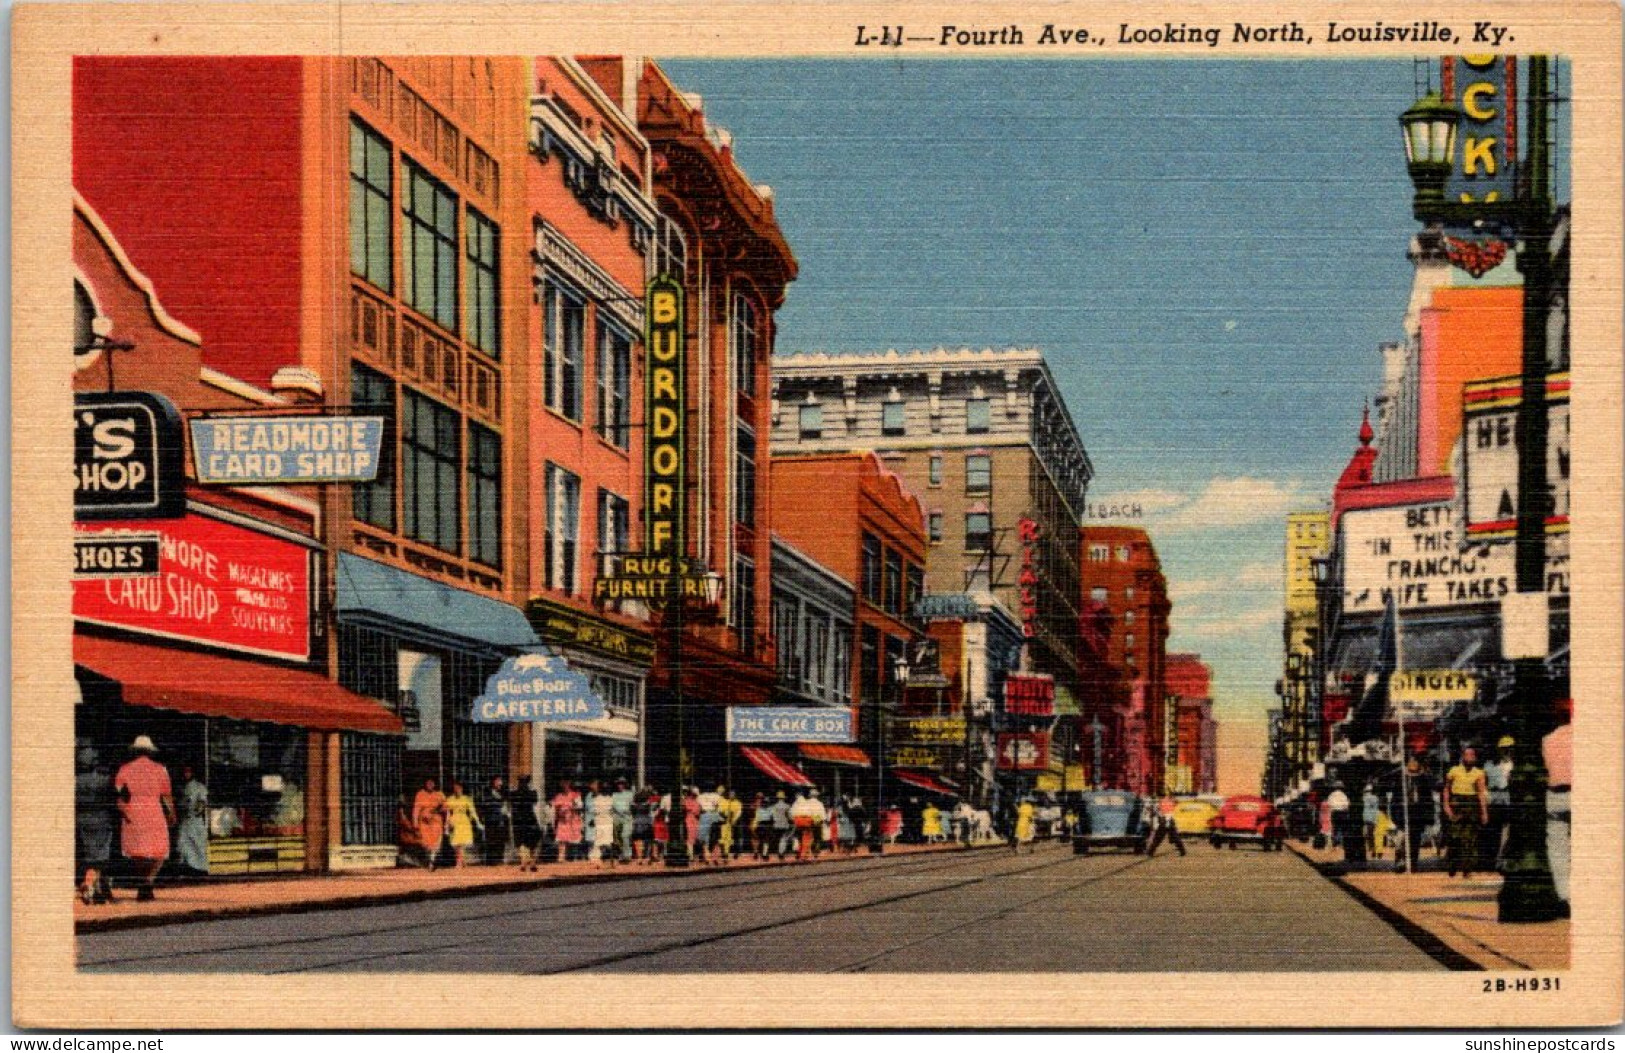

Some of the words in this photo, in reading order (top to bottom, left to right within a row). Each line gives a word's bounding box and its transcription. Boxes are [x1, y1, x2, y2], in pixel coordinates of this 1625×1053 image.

[1037, 24, 1105, 46] Ave.,
[1118, 23, 1221, 47] Looking
[1232, 22, 1313, 45] North,
[1327, 22, 1461, 45] Louisville,
[1472, 22, 1515, 46] Ky.
[1460, 55, 1498, 203] CK
[652, 292, 679, 551] BURDORF
[213, 423, 367, 452] READMORE
[210, 453, 282, 478] CARD
[297, 452, 371, 477] SHOP
[228, 561, 295, 594] MAGAZINES
[595, 578, 707, 598] FURNITR
[1446, 576, 1509, 601] TAKES
[166, 573, 220, 624] SHOP
[481, 697, 589, 720] CAFETERIA
[1482, 977, 1561, 992] 2B-H931
